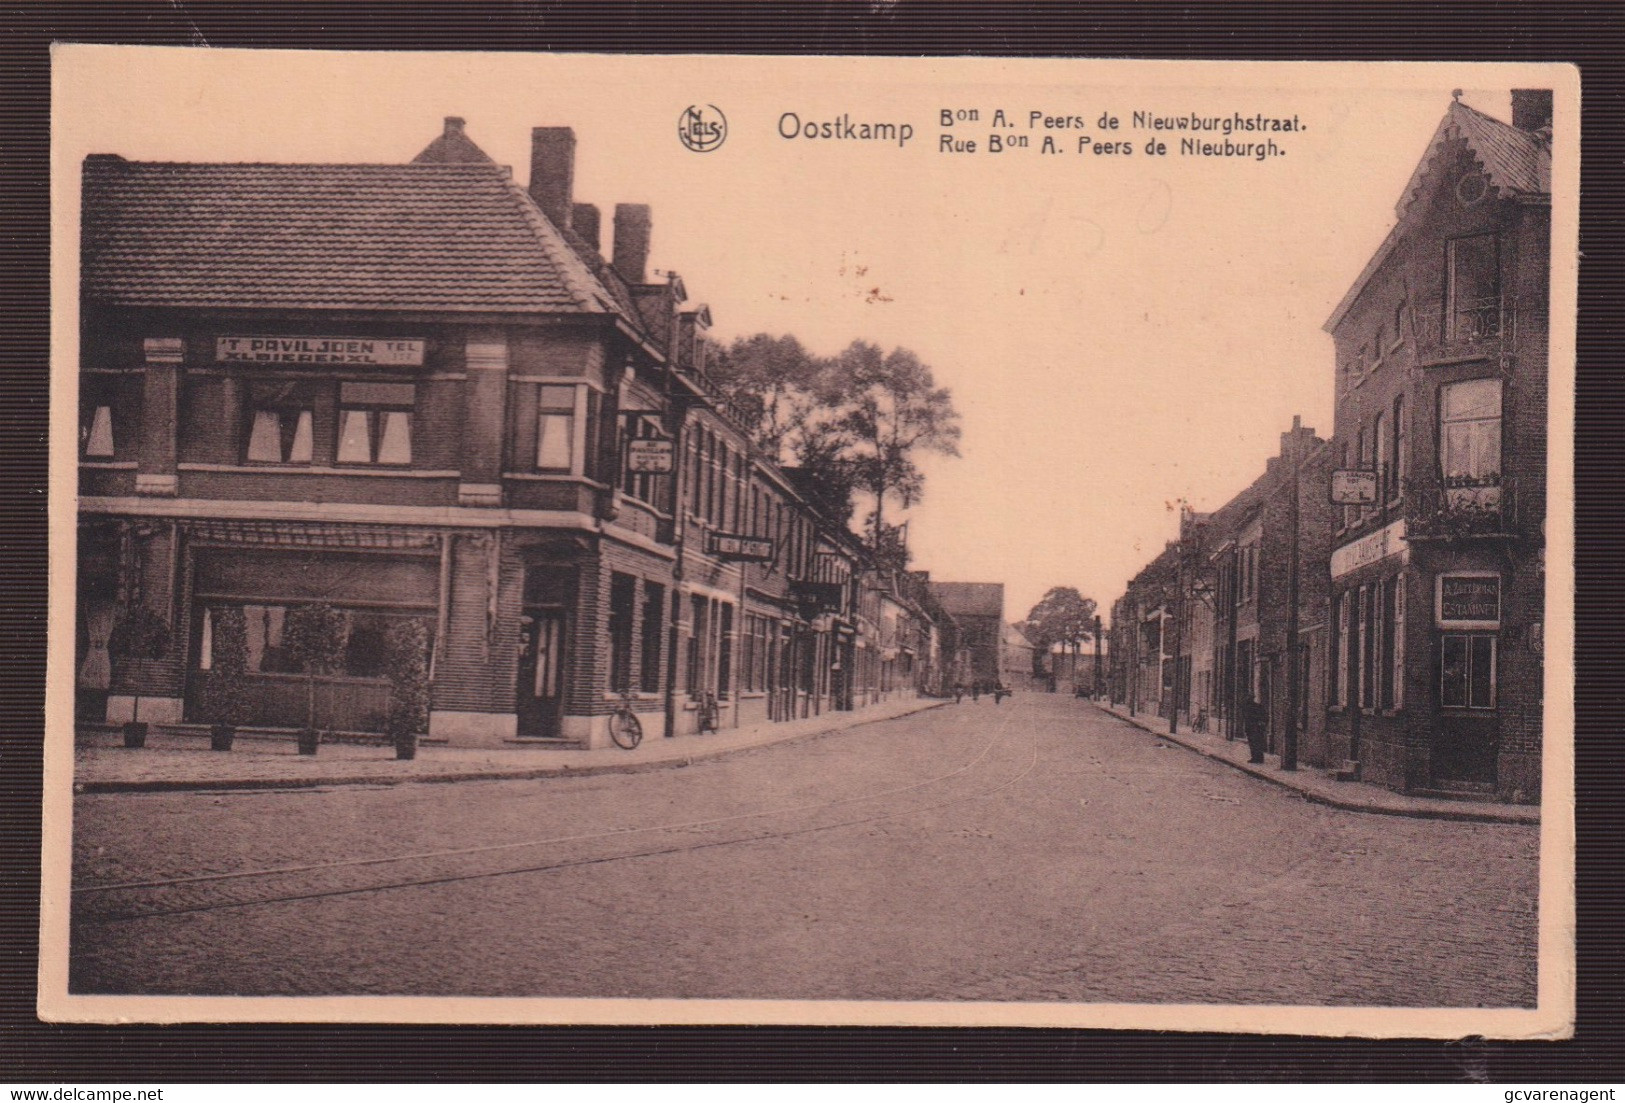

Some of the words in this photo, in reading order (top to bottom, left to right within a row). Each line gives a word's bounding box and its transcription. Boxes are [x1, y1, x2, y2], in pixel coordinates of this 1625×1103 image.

[778, 112, 913, 147] Oostkamp
[940, 109, 979, 126] Bon
[992, 109, 1014, 128] A.
[1029, 111, 1084, 129] Peers
[1097, 111, 1119, 130] de
[1133, 110, 1307, 135] Nieuwburghstraat.
[940, 134, 977, 153] Rue
[988, 134, 1029, 153] Bon
[1041, 136, 1063, 155] A.
[1078, 136, 1132, 155] Peers
[1145, 137, 1167, 156] de
[251, 340, 374, 353] PAVILJOEN
[386, 342, 416, 352] TEL
